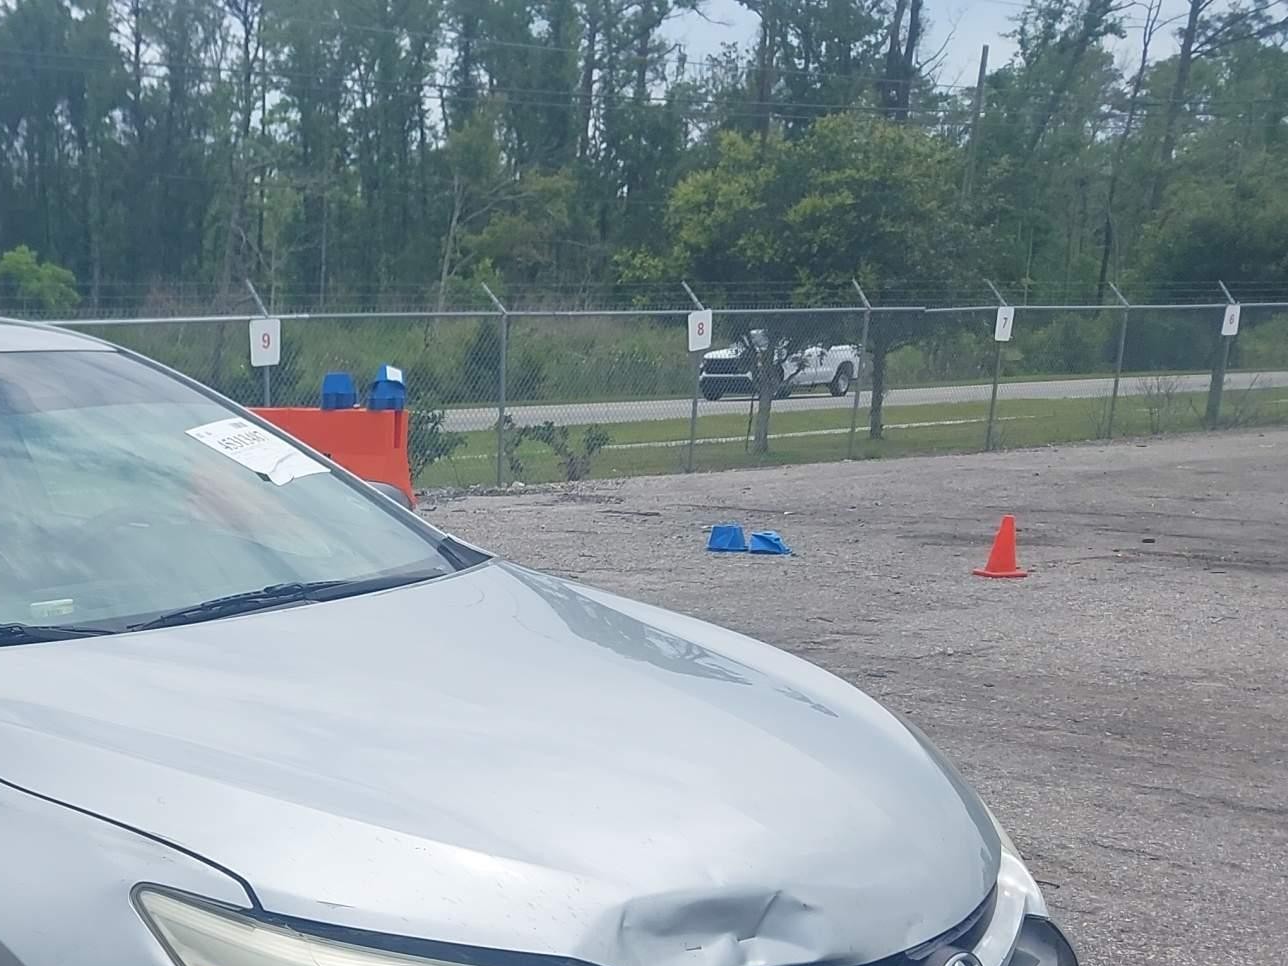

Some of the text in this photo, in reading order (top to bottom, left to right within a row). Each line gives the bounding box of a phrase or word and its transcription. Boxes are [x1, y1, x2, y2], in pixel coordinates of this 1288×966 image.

[697, 322, 704, 336] 8
[1003, 316, 1009, 328] 7
[262, 333, 270, 349] 9
